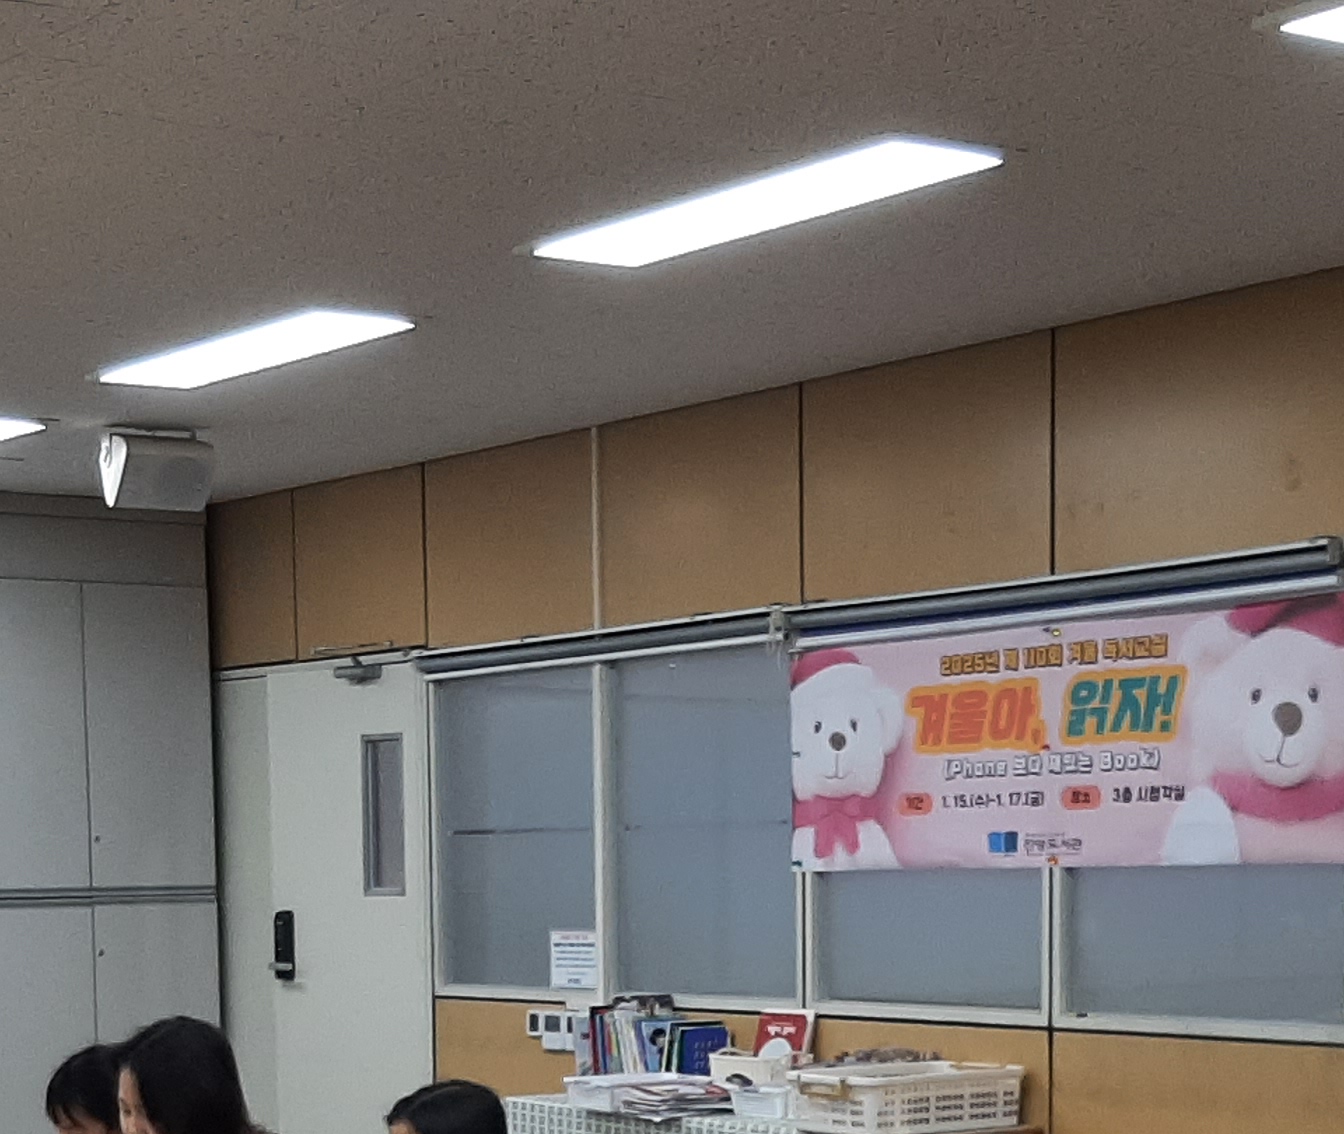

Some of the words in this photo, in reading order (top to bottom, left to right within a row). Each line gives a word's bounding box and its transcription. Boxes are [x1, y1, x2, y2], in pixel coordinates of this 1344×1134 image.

[940, 650, 1000, 676] 2025년
[1103, 633, 1169, 662] 독서교실
[911, 686, 1042, 746] 겨울아,
[1066, 675, 1180, 737] 읽자!
